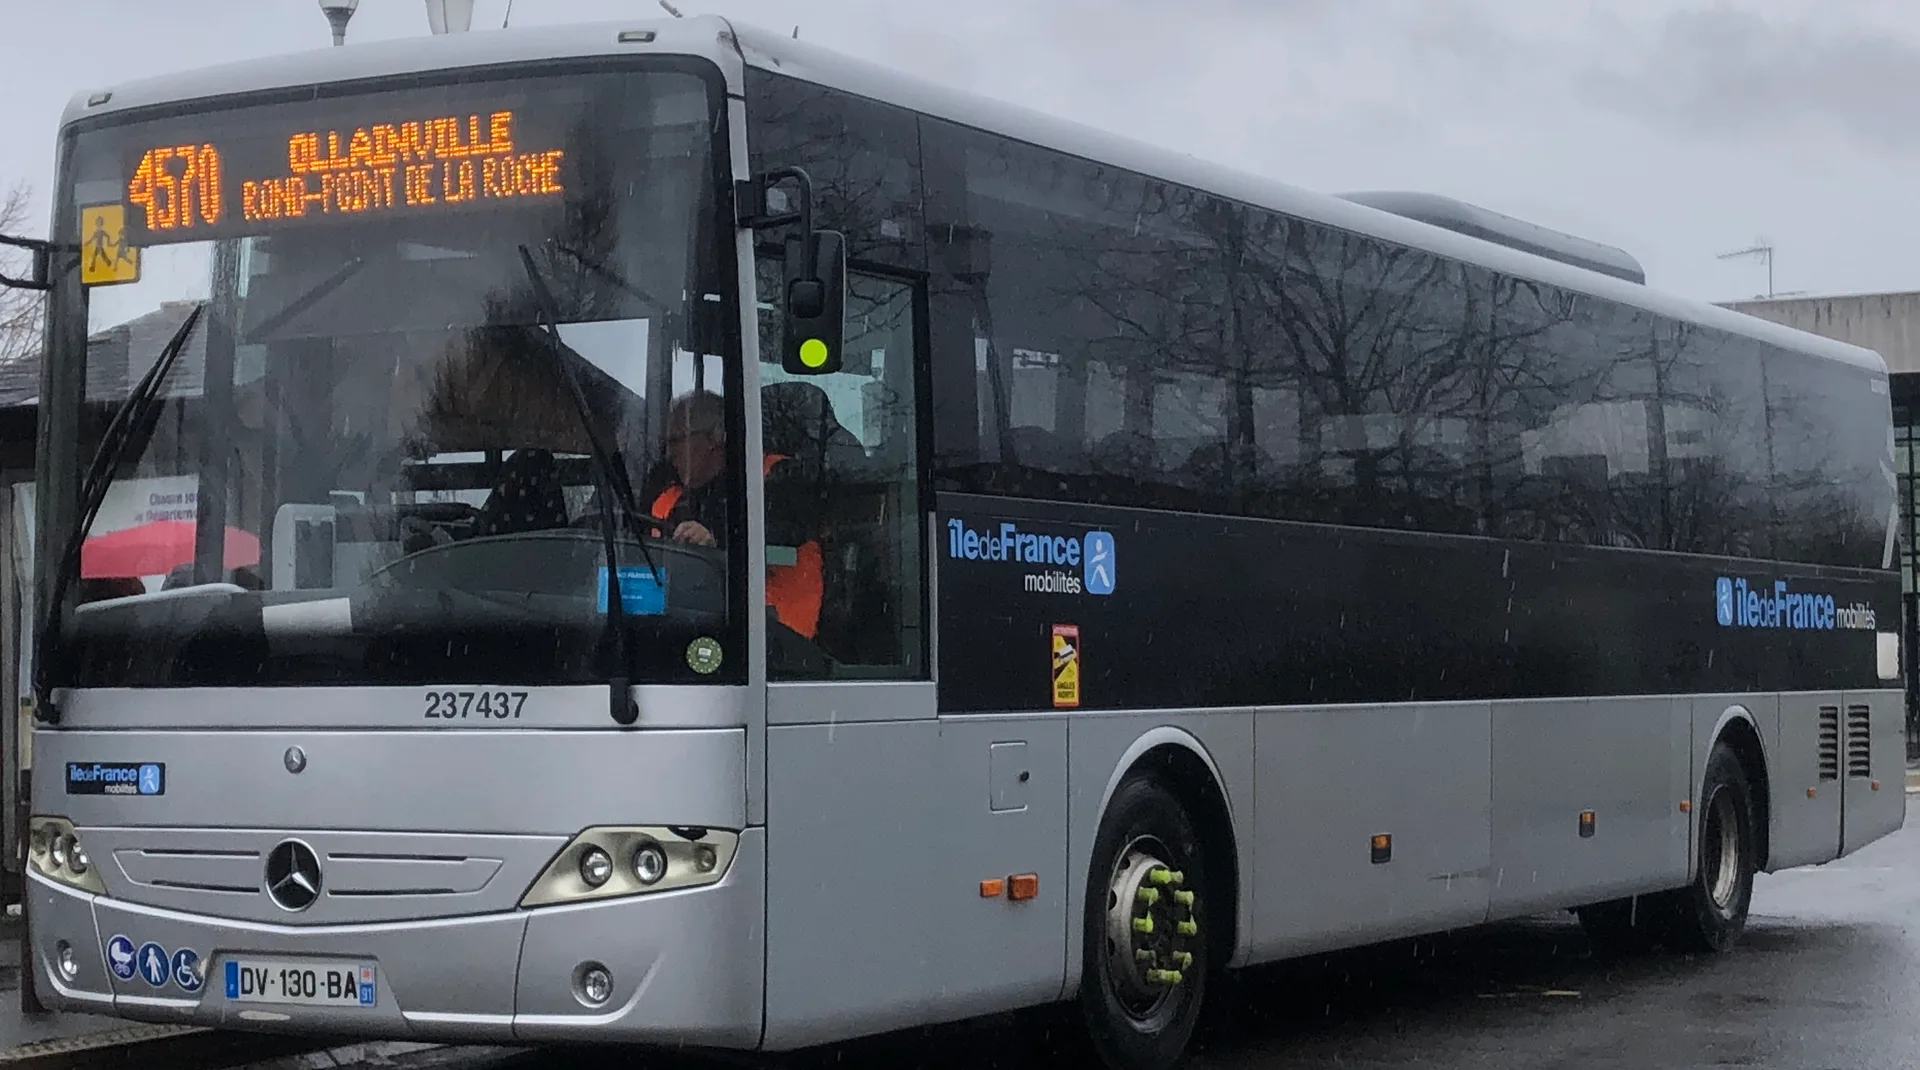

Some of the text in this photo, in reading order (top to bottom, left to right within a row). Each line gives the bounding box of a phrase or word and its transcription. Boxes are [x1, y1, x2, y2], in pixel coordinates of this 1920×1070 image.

[289, 111, 514, 173] OLLAINVILLE
[128, 143, 220, 230] 4570
[242, 150, 565, 221] ROND-POINT DE LA ROCHE
[1024, 569, 1081, 594] mobilités
[1836, 600, 1876, 630] mobilités
[424, 691, 529, 719] 237437
[360, 987, 374, 1001] 91
